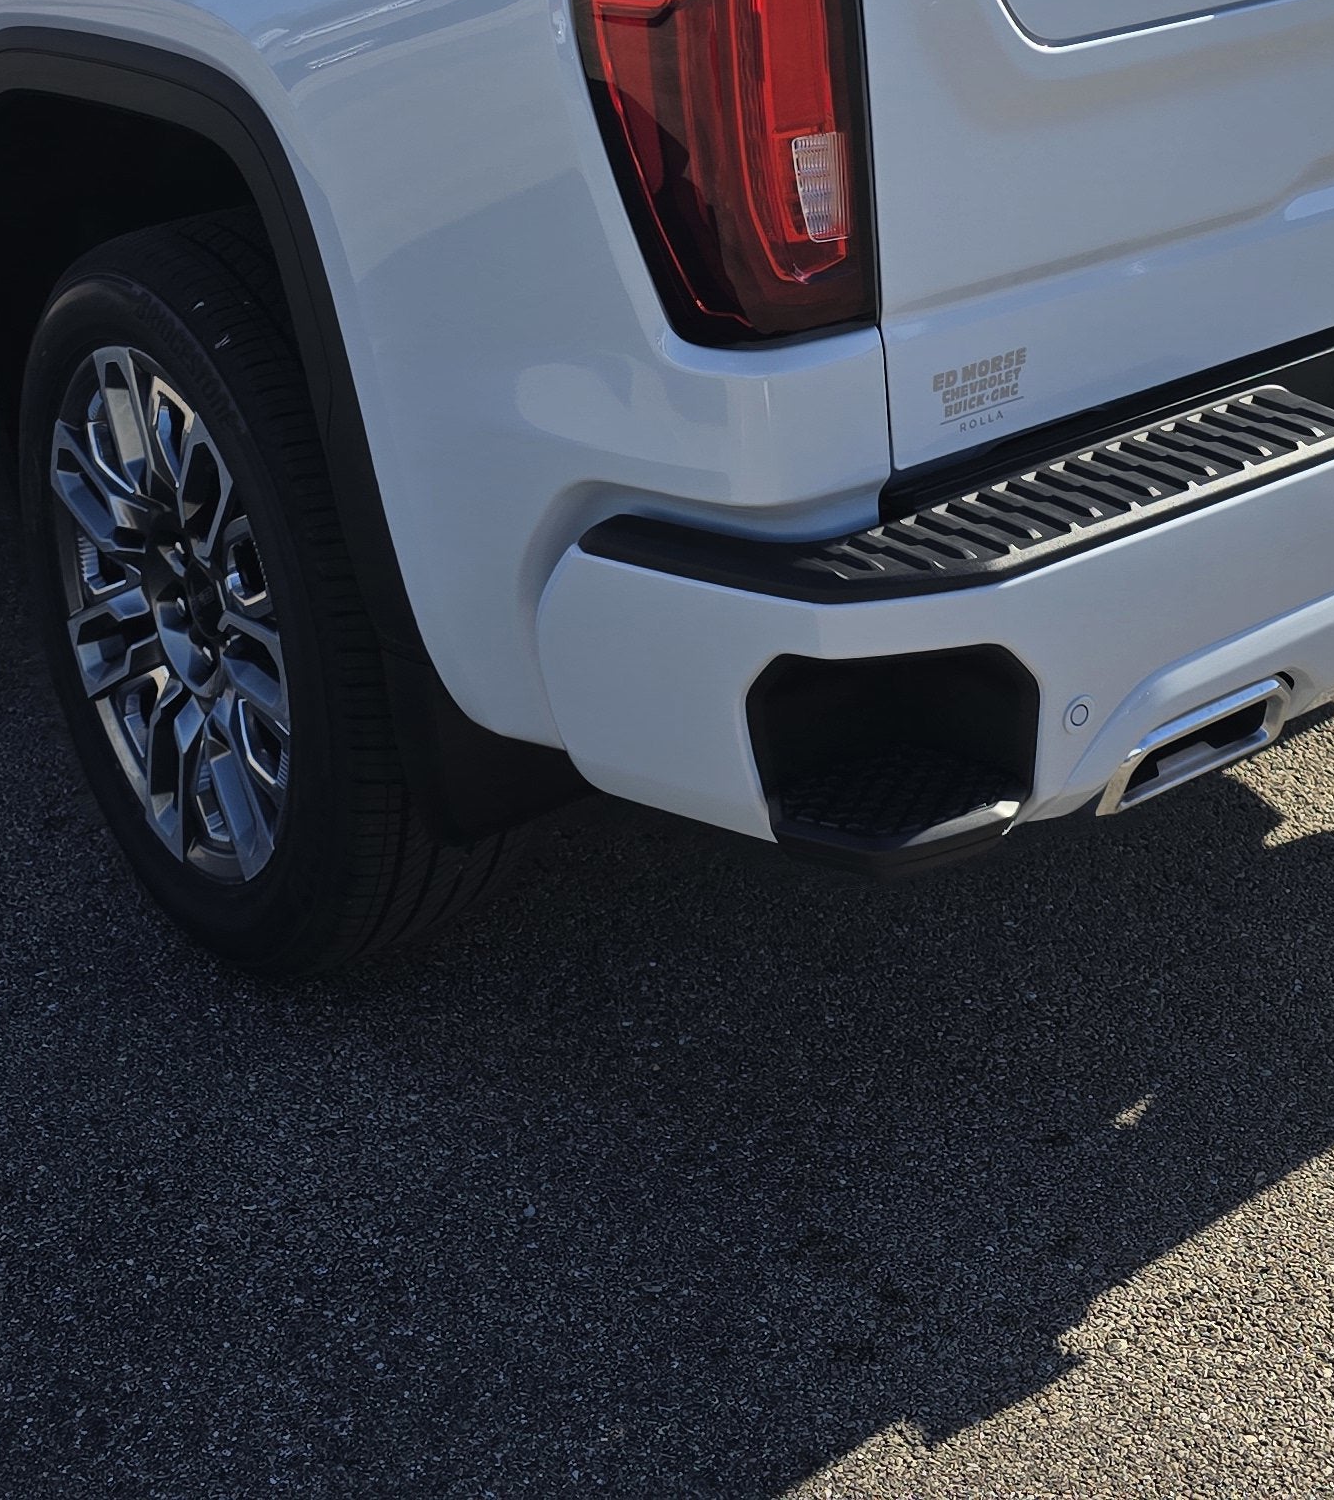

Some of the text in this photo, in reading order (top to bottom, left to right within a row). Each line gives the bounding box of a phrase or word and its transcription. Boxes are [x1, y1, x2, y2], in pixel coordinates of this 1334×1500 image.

[932, 347, 1027, 392] ED MORSE
[942, 366, 1022, 404] CHEVROLET
[959, 410, 1004, 433] ROLLA
